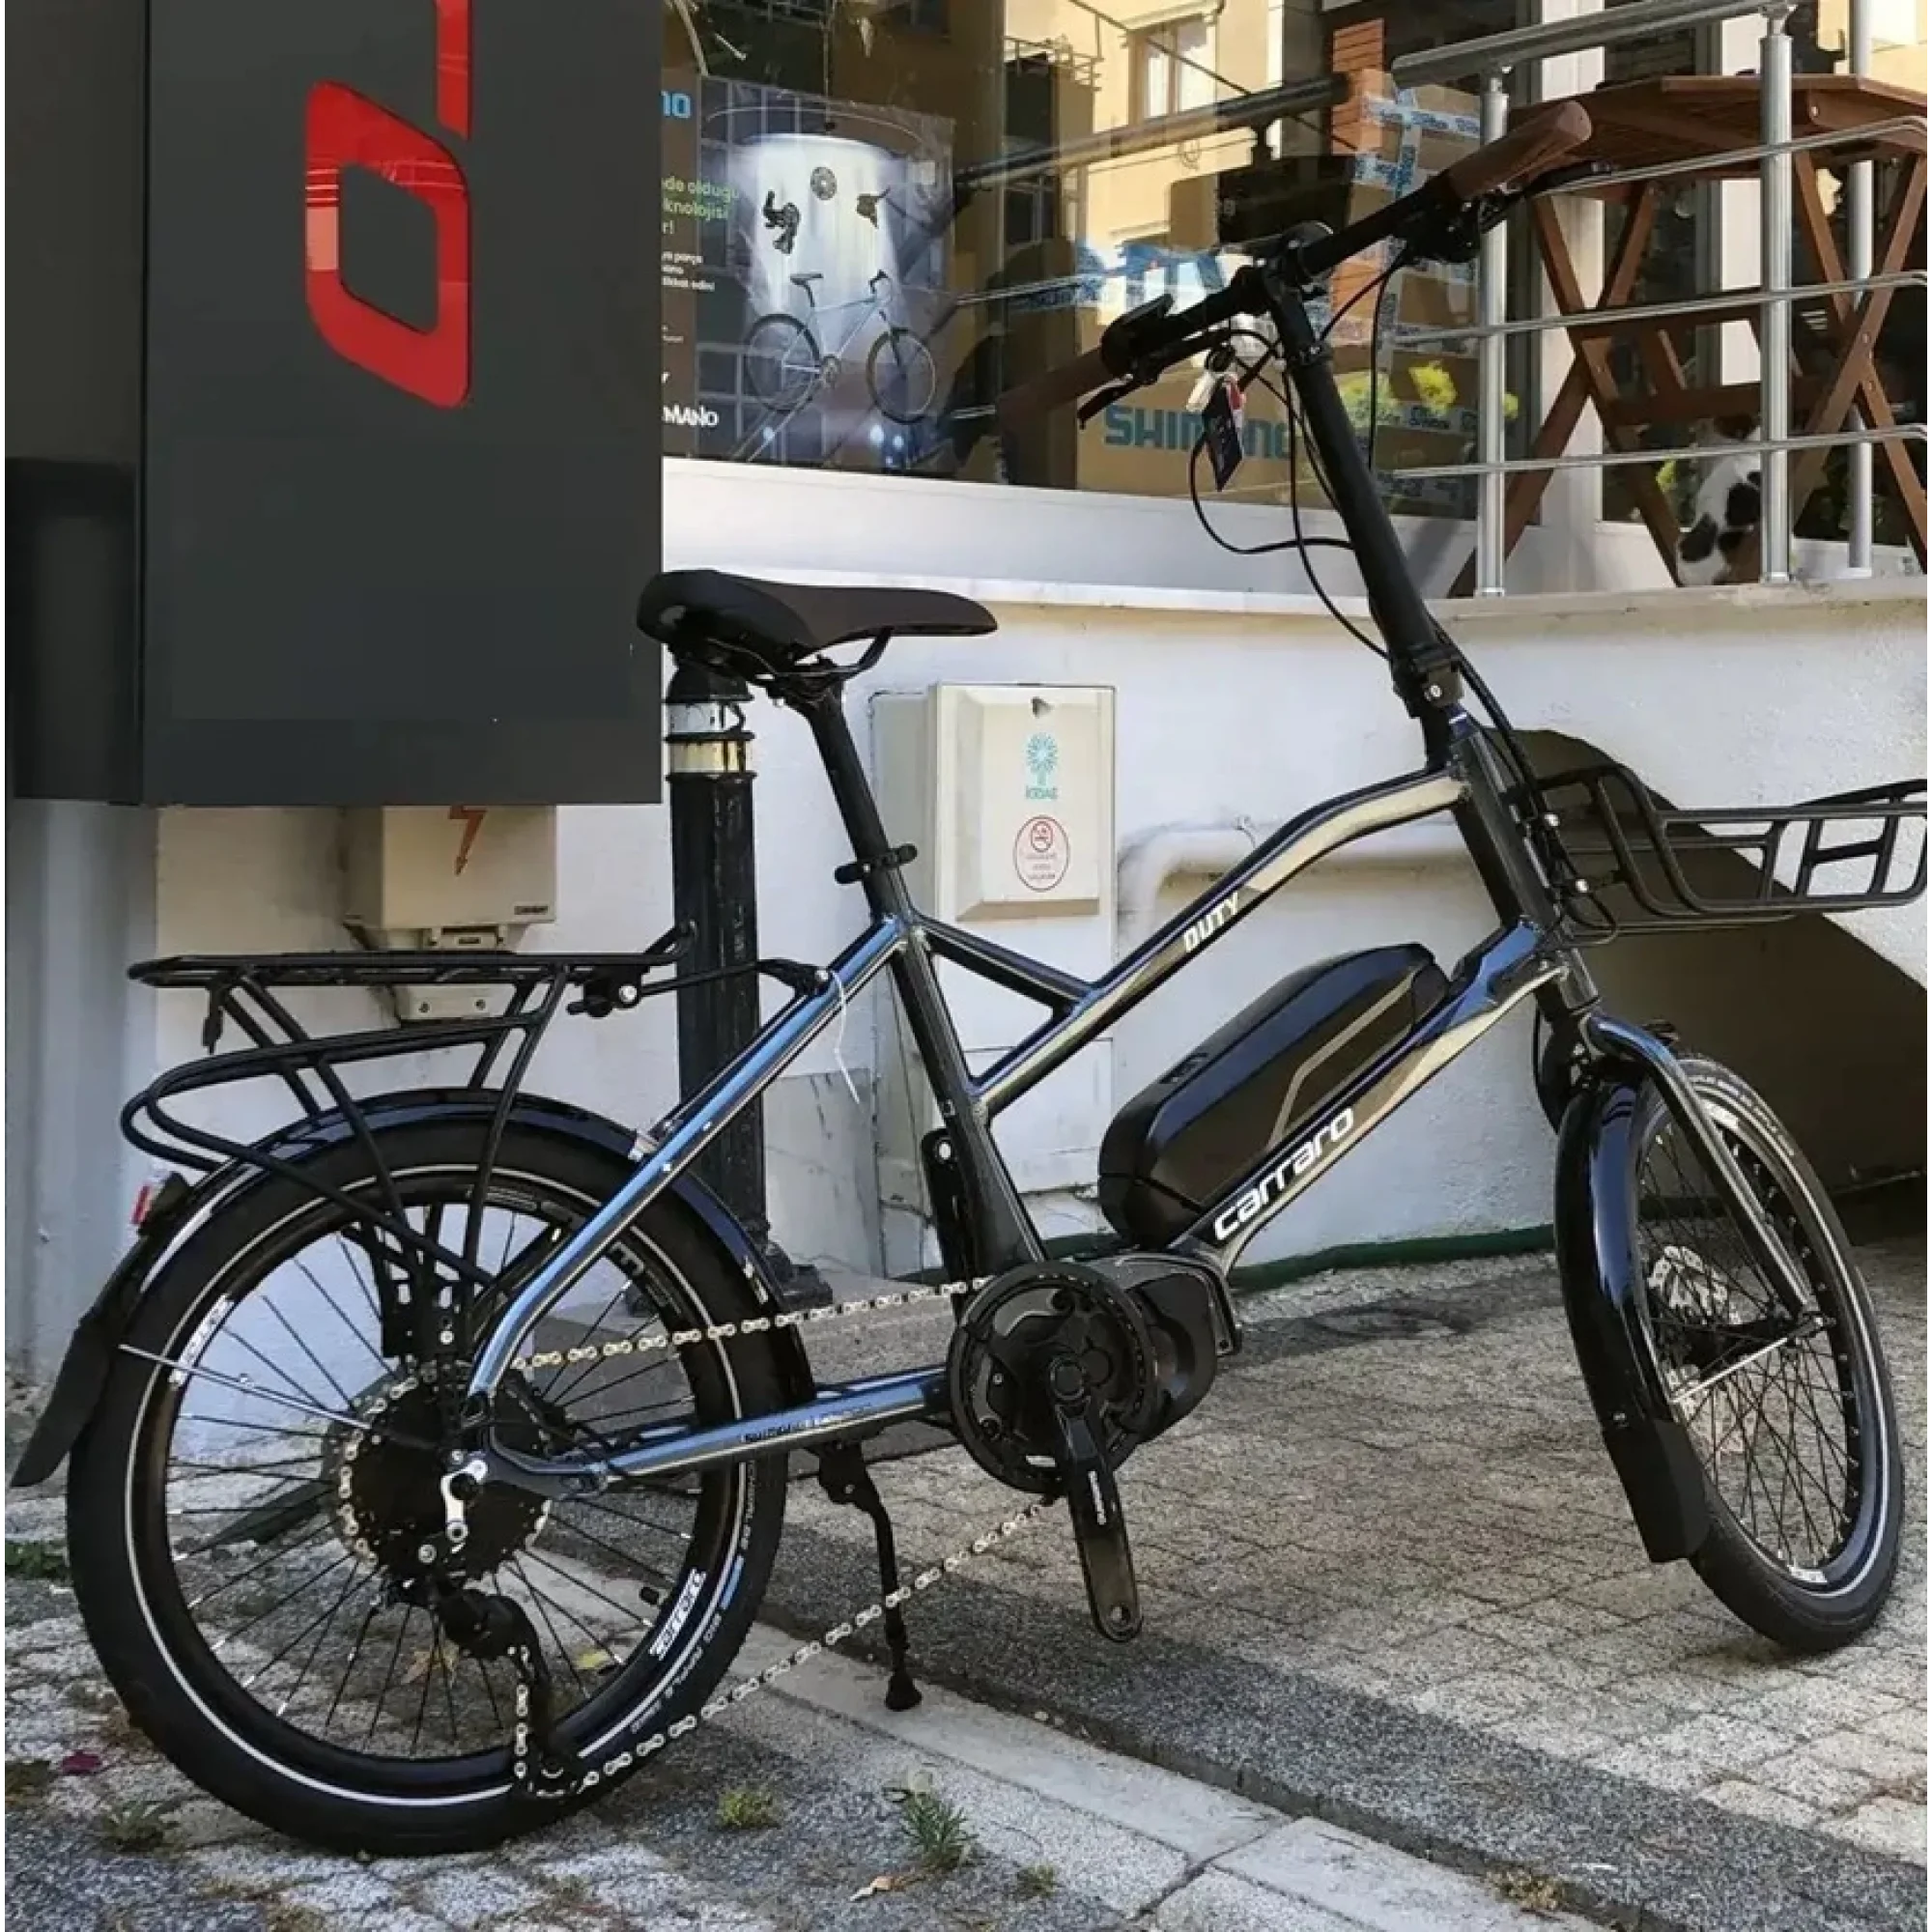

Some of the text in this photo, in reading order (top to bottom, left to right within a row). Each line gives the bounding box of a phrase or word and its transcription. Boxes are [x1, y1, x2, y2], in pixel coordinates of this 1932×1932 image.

[1105, 403, 1292, 460] SHIMNO
[1182, 891, 1239, 953] DUTY
[1213, 1107, 1354, 1240] carraro
